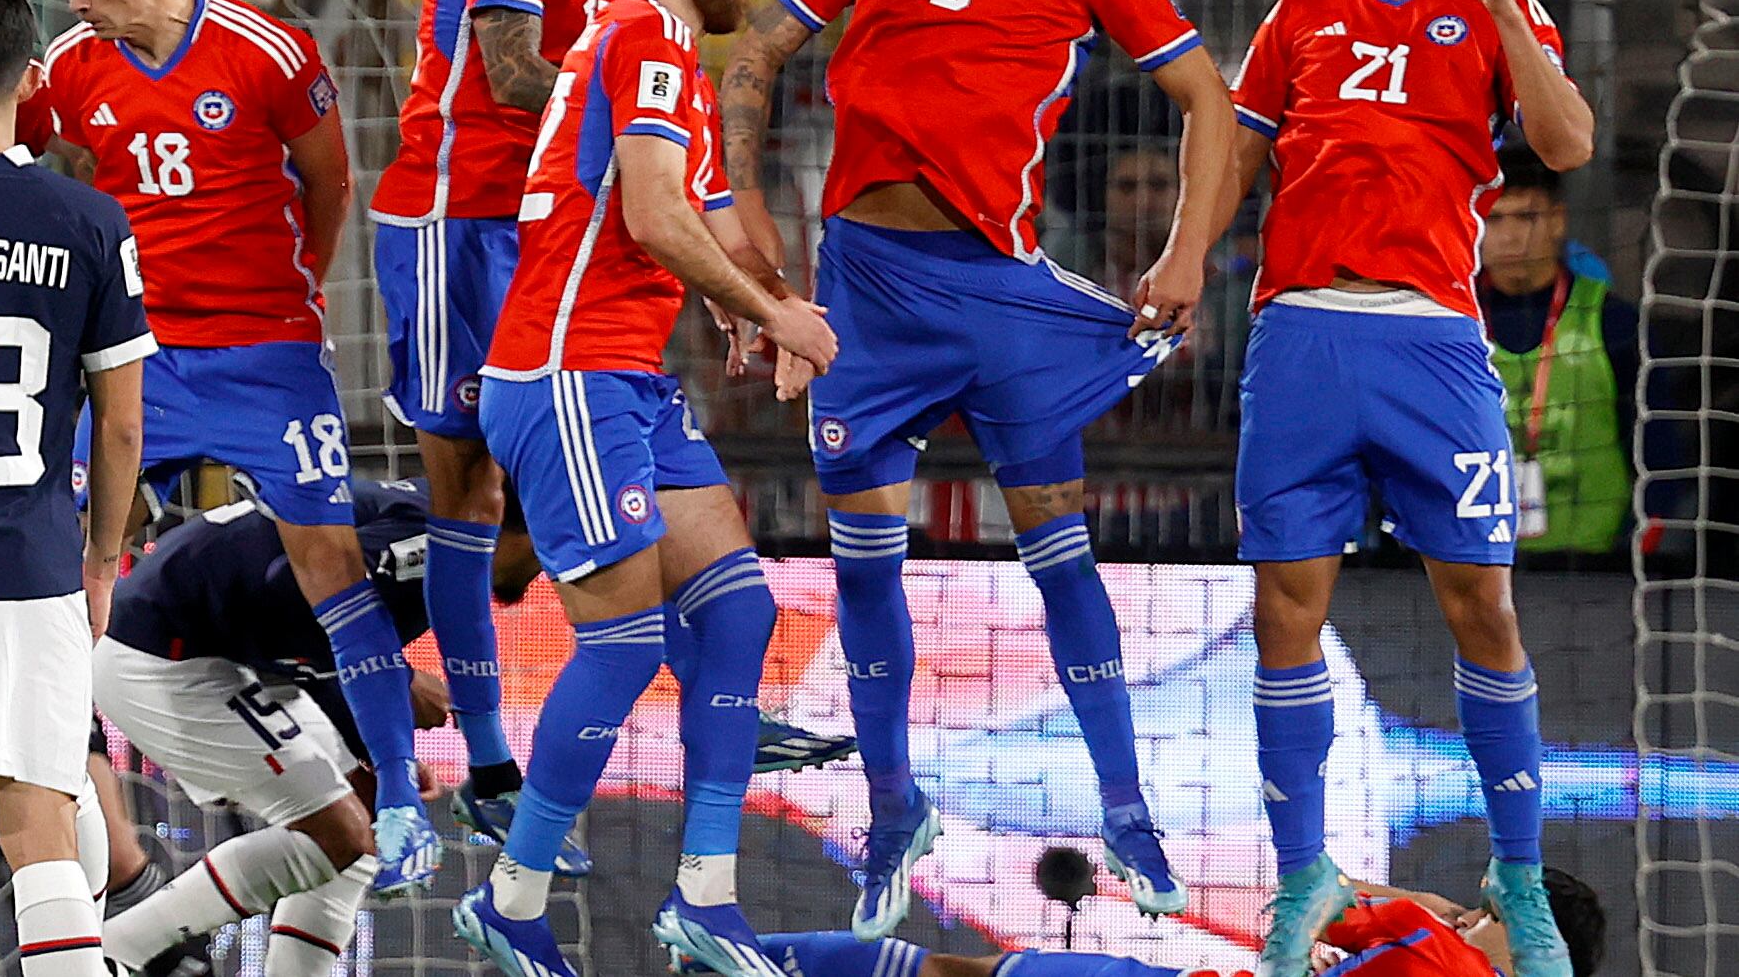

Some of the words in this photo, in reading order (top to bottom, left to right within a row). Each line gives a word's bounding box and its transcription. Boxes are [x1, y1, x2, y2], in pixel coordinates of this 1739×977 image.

[1339, 40, 1411, 105] 21
[126, 132, 195, 197] 18
[282, 413, 349, 485] 18
[1453, 449, 1513, 518] 21
[338, 652, 406, 684] CHILE
[225, 681, 302, 751] 15
